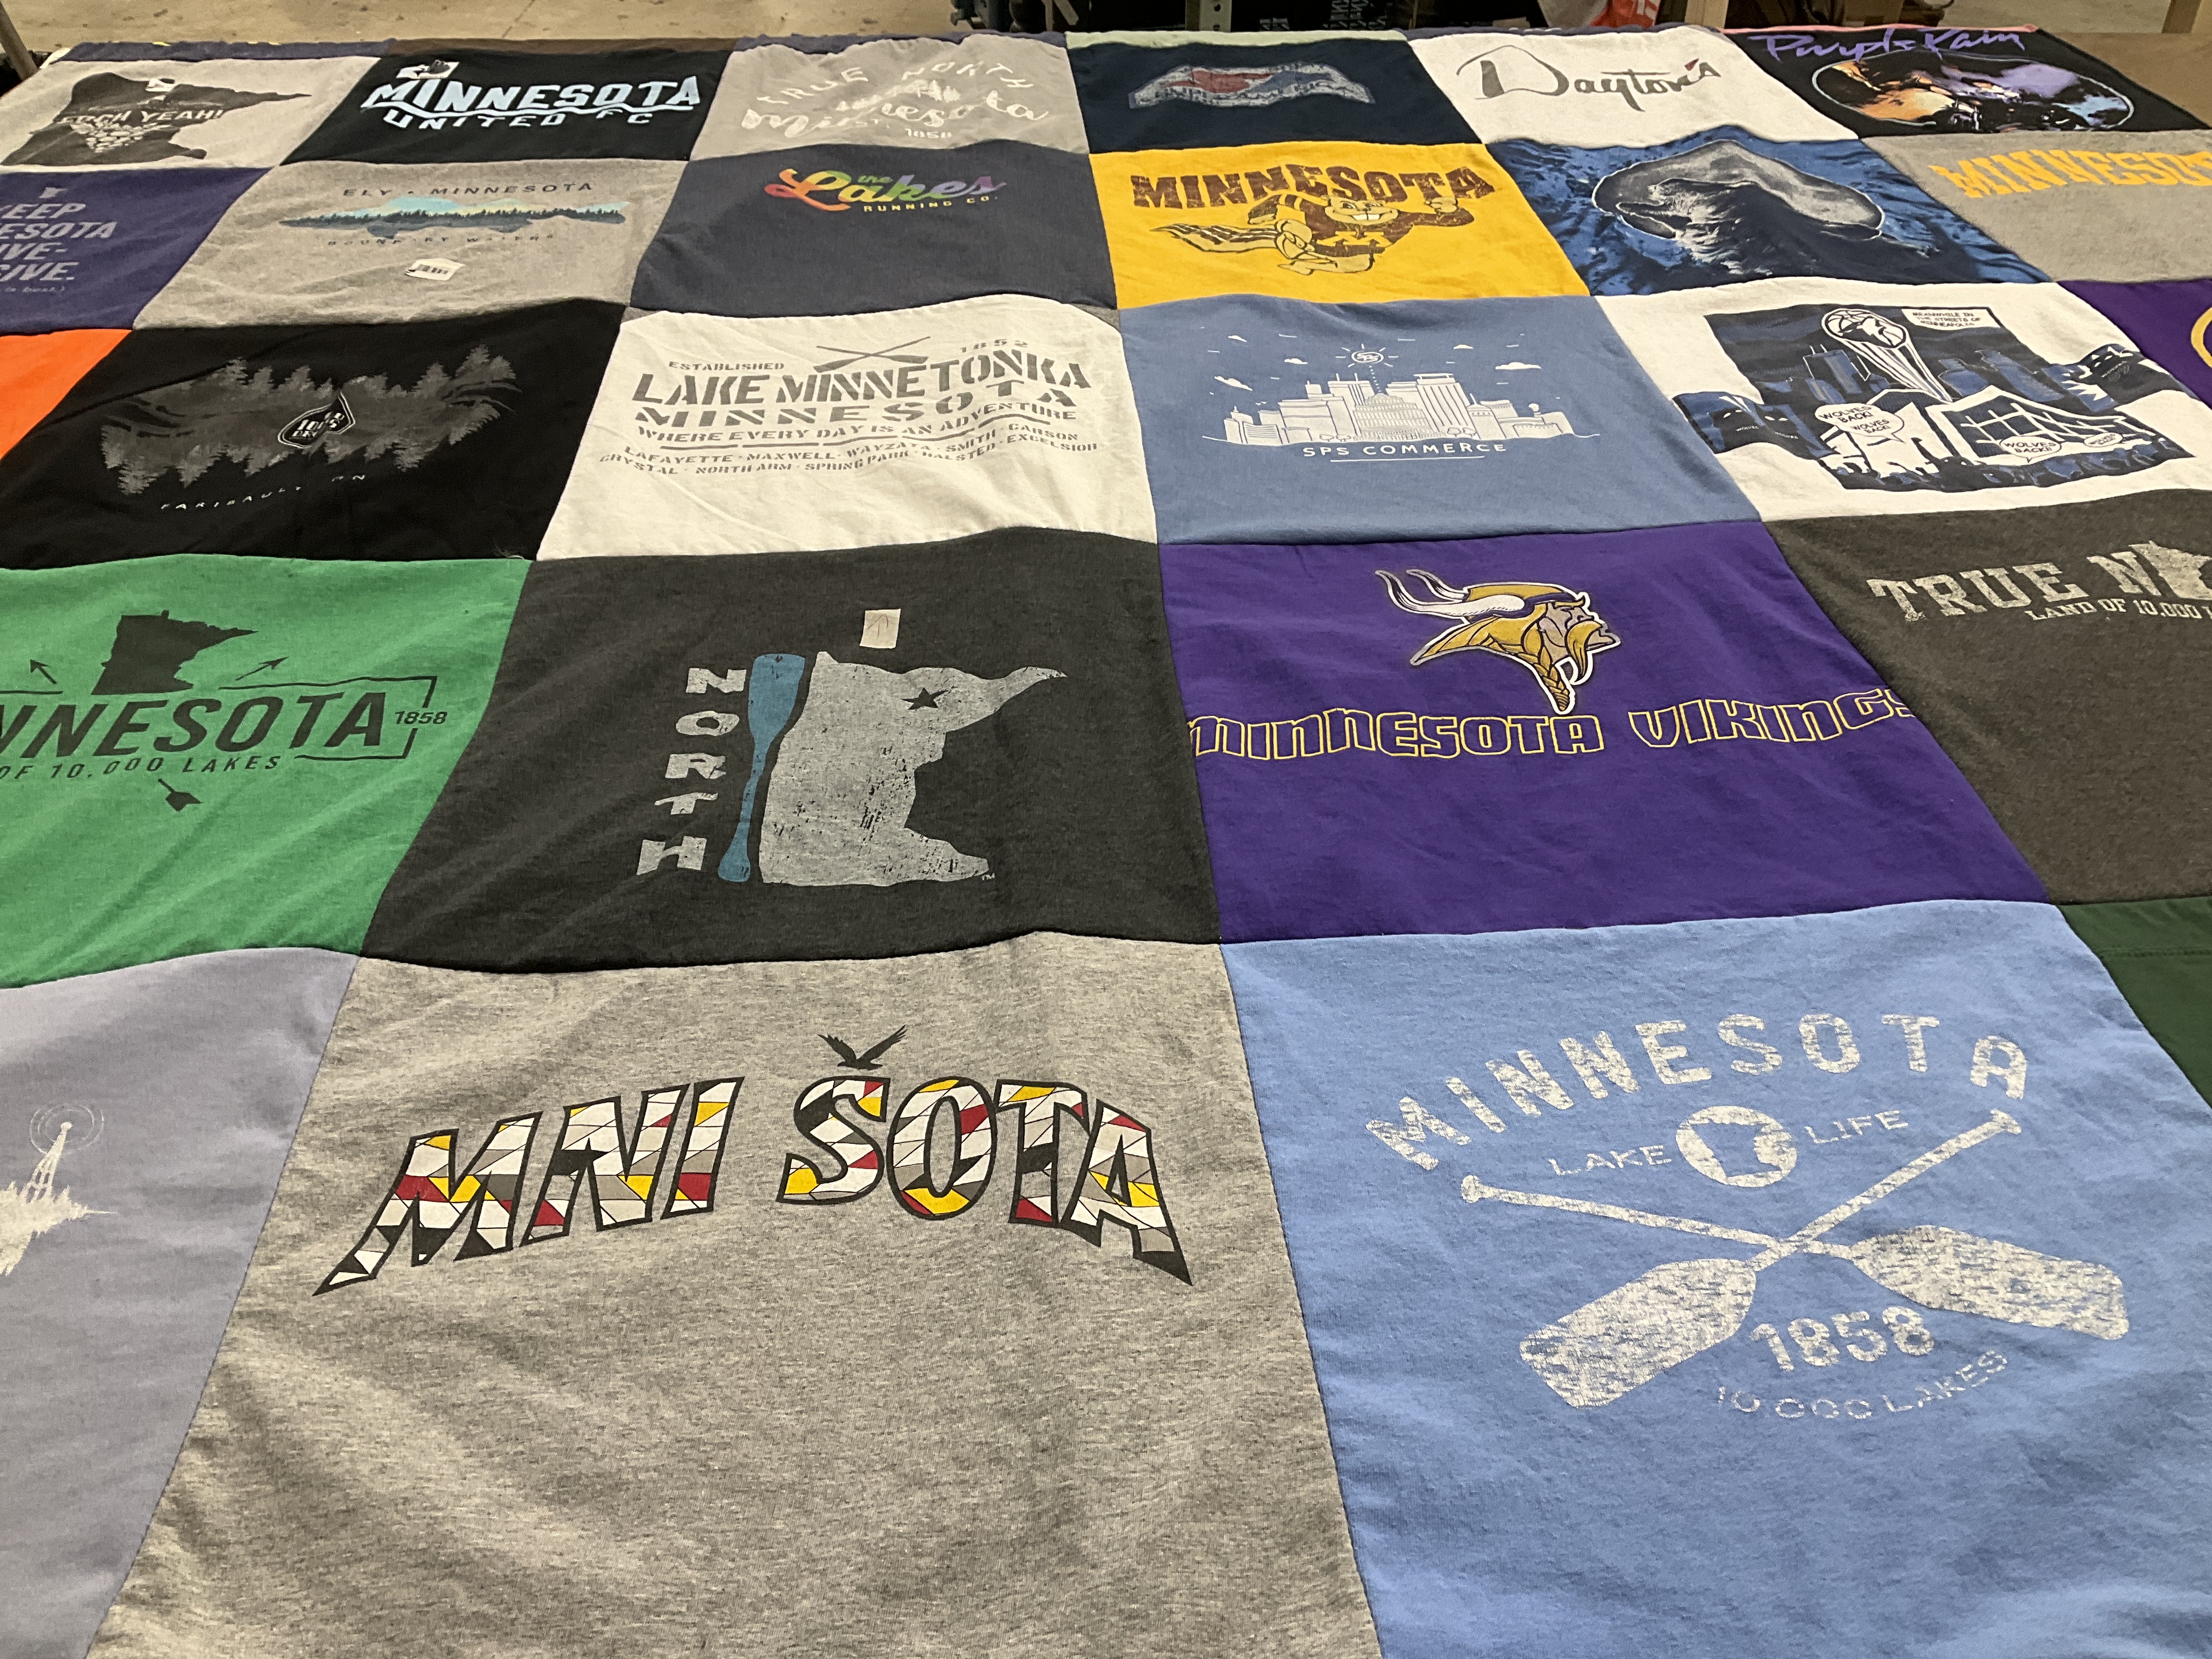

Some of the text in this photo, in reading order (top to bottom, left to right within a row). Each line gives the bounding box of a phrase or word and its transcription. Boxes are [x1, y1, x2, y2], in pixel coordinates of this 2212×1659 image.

[360, 76, 702, 112] MINNESOTA
[757, 61, 1034, 104] TRUE NORTH
[383, 109, 657, 130] UNITED FC
[342, 182, 593, 196] ELY MINNESOTA
[764, 168, 1008, 212] Lakes
[864, 200, 952, 212] RUNNING
[1130, 164, 1496, 210] MINNESOTA
[632, 349, 1091, 405] LAKE MINNETONKA
[668, 361, 785, 371] ESTABLISHED
[635, 379, 1077, 427] MINNESOTA
[637, 426, 724, 442] WHERE
[729, 429, 809, 441] EVERY
[816, 425, 864, 438] DAY
[901, 425, 932, 435] AN
[940, 402, 1077, 432] ADVENTURE
[1818, 405, 1872, 420] WOLVES
[624, 446, 734, 464] LAFAYETTE
[746, 452, 836, 461] MAXWELL
[945, 428, 996, 453] SMITH
[1008, 422, 1079, 441] CARSON
[1850, 419, 1890, 431] WOLVES
[600, 453, 679, 475] CRYSTAL
[695, 464, 753, 474] NORTH
[757, 463, 792, 472] ARM
[804, 459, 864, 471] SPRING
[867, 450, 909, 465] PARK
[1007, 434, 1098, 452] EXCELSIOR
[1303, 443, 1508, 457] SPS COMMERCE
[1866, 562, 2090, 622] TRUE
[2025, 600, 2097, 620] LAND
[2097, 598, 2127, 612] OF
[394, 709, 448, 725] 1858
[1187, 707, 1605, 760] MINNESOTA
[52, 757, 164, 779] 10,000
[182, 755, 281, 773] LAKES
[636, 667, 747, 876] NORTH
[1365, 1013, 2028, 1171] MINNESOTA
[1549, 1110, 1909, 1176] LAKE LIFE
[311, 1076, 746, 1297] MNI
[1751, 1306, 1936, 1373] 1858
